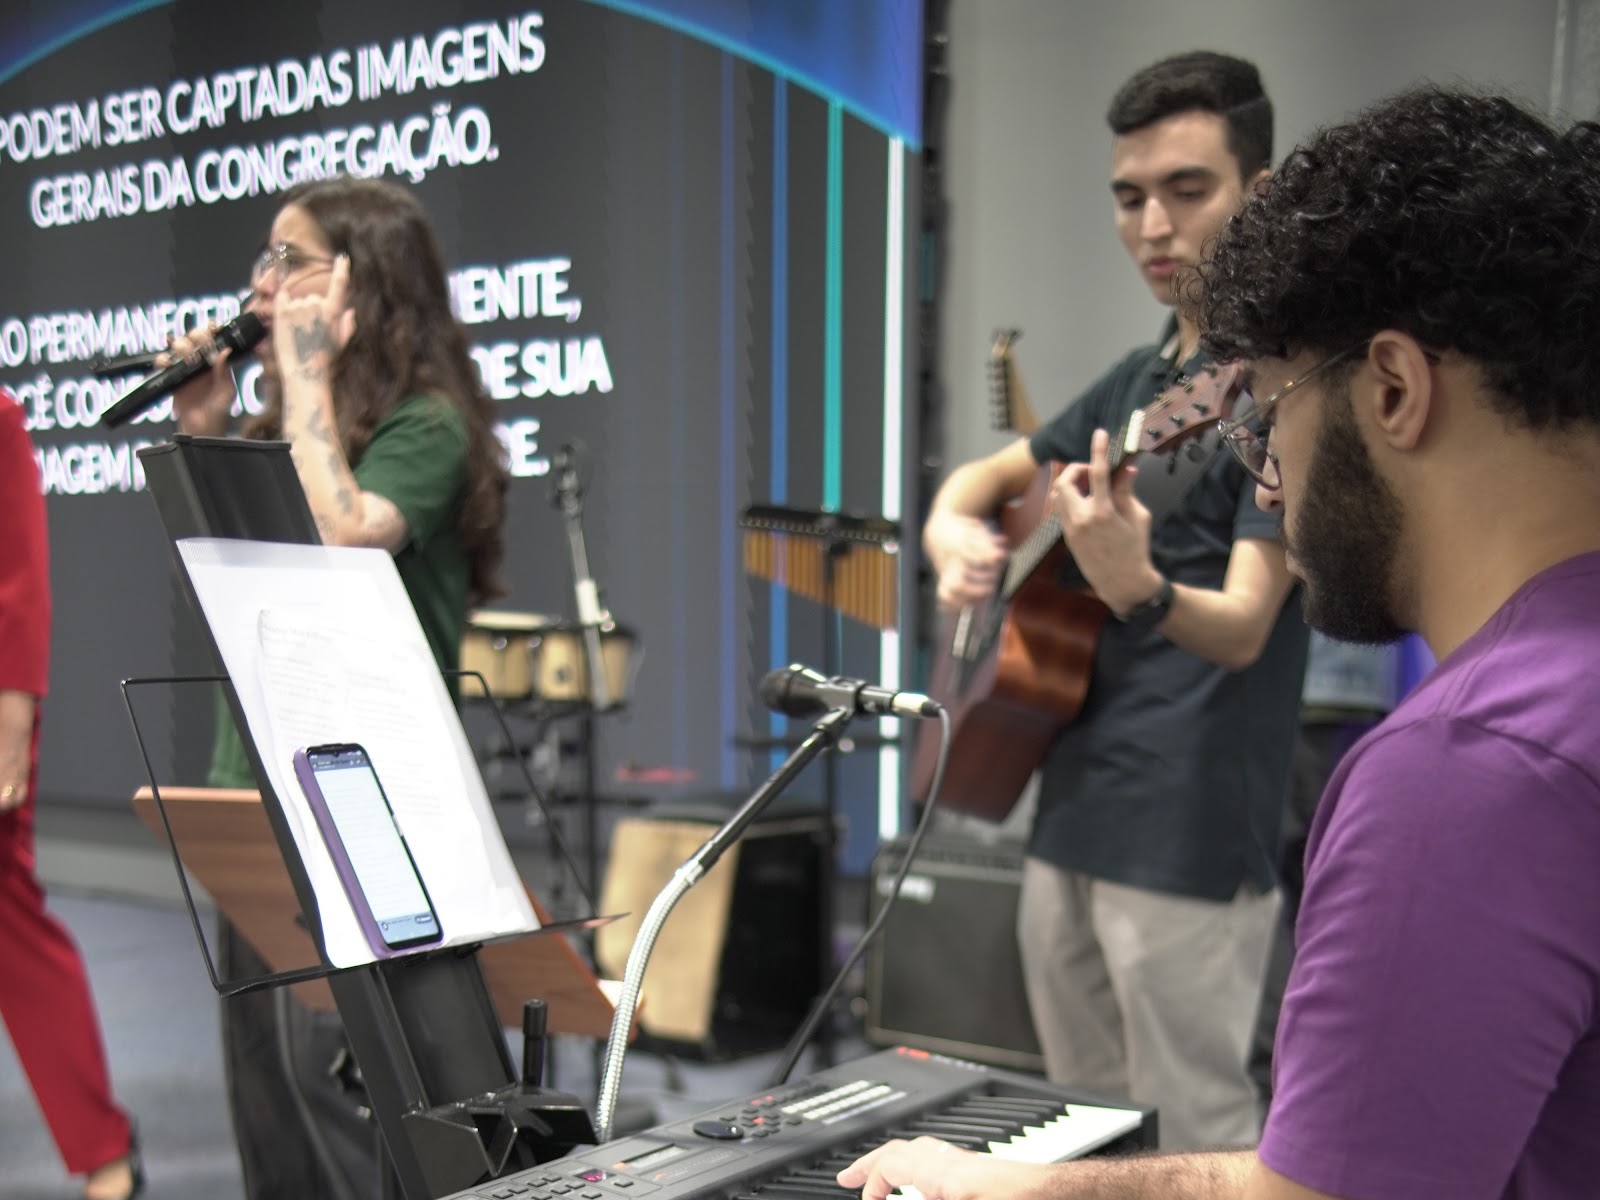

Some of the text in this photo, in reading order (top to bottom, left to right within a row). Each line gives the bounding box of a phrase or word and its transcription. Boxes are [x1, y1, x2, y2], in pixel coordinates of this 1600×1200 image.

[103, 87, 166, 146] SER
[166, 48, 353, 135] CAPTADAS
[357, 12, 546, 101] IMAGENS
[31, 103, 499, 228] GERAIS DA CONGREGAÇÃO.
[521, 336, 613, 398] SUA
